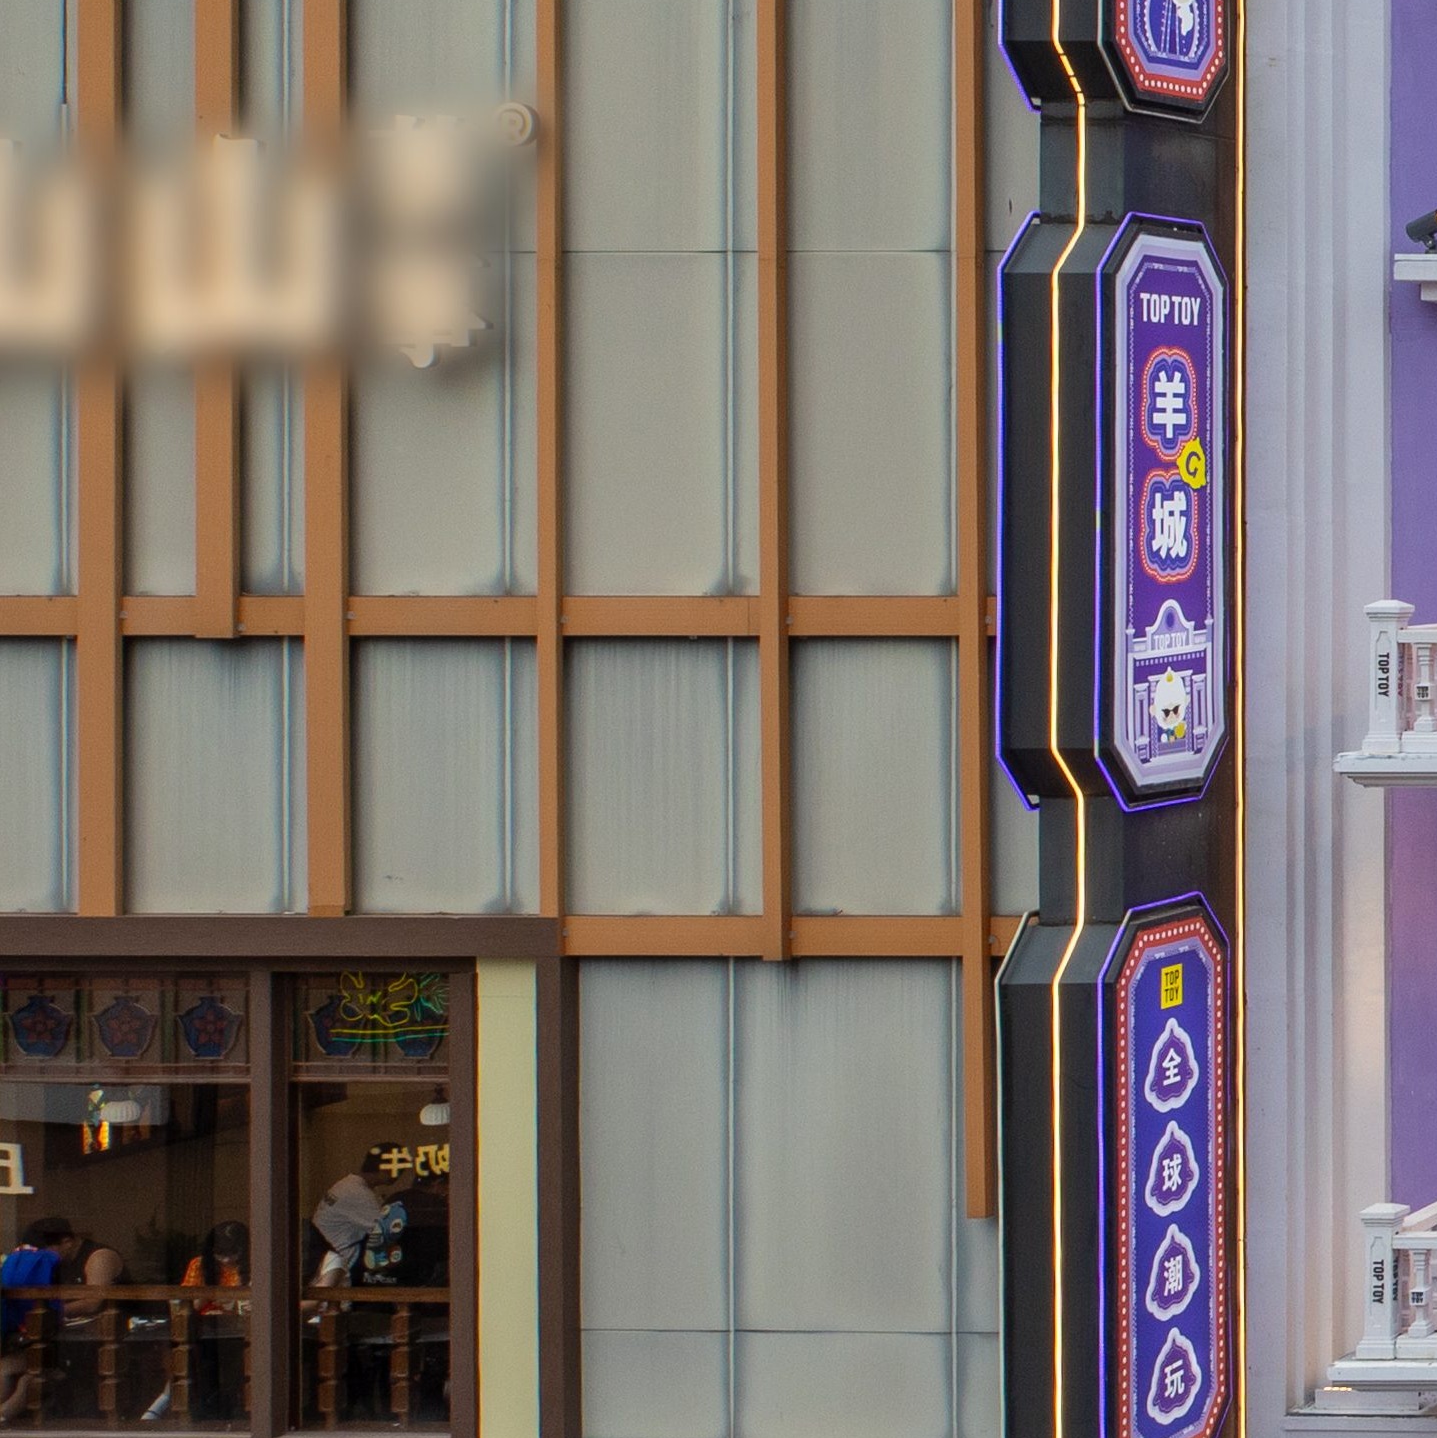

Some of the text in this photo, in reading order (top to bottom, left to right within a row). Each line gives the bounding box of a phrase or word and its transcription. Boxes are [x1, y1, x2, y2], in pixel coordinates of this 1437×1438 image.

[1140, 292, 1202, 327] TOP TOY
[1152, 371, 1187, 560] 羊城
[1164, 968, 1181, 987] TOP
[1164, 985, 1181, 1004] TOY
[1162, 1047, 1186, 1397] 全球潮玩
